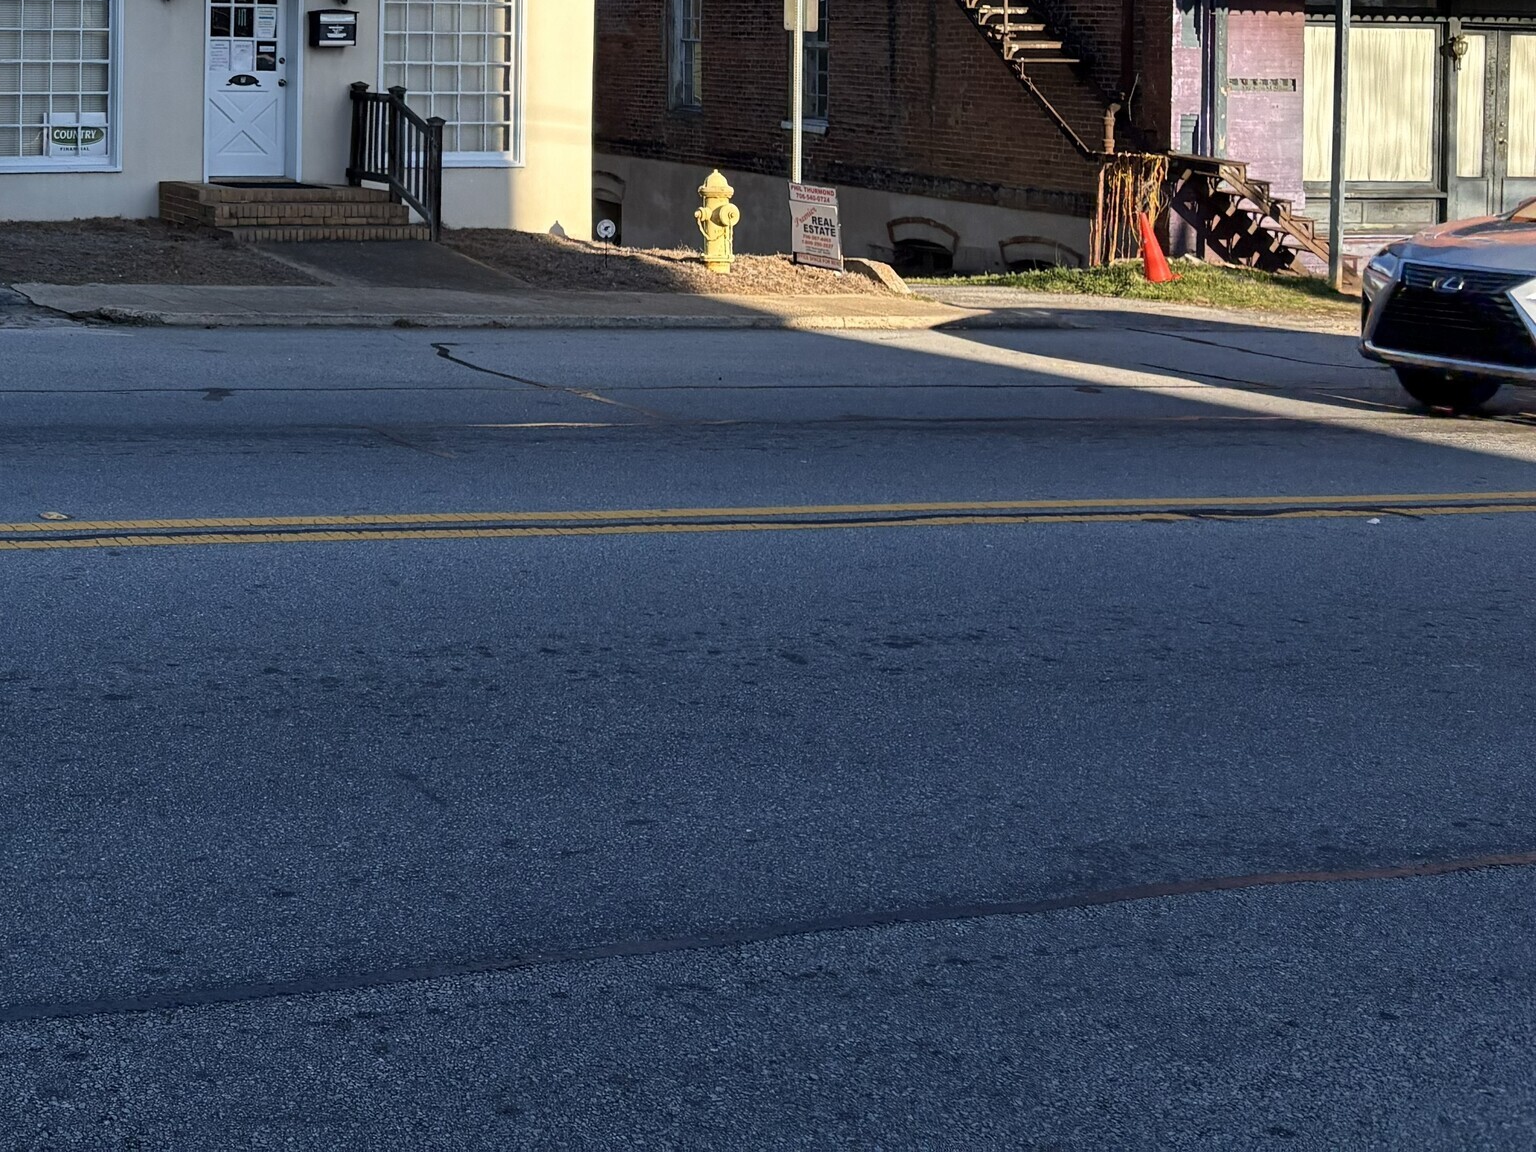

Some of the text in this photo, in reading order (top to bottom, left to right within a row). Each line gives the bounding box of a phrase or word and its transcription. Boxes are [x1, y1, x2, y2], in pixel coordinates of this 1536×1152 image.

[54, 129, 96, 139] COUNTRY
[804, 187, 834, 196] THURMOND
[812, 216, 835, 227] REAL
[804, 224, 836, 237] ESTATE
